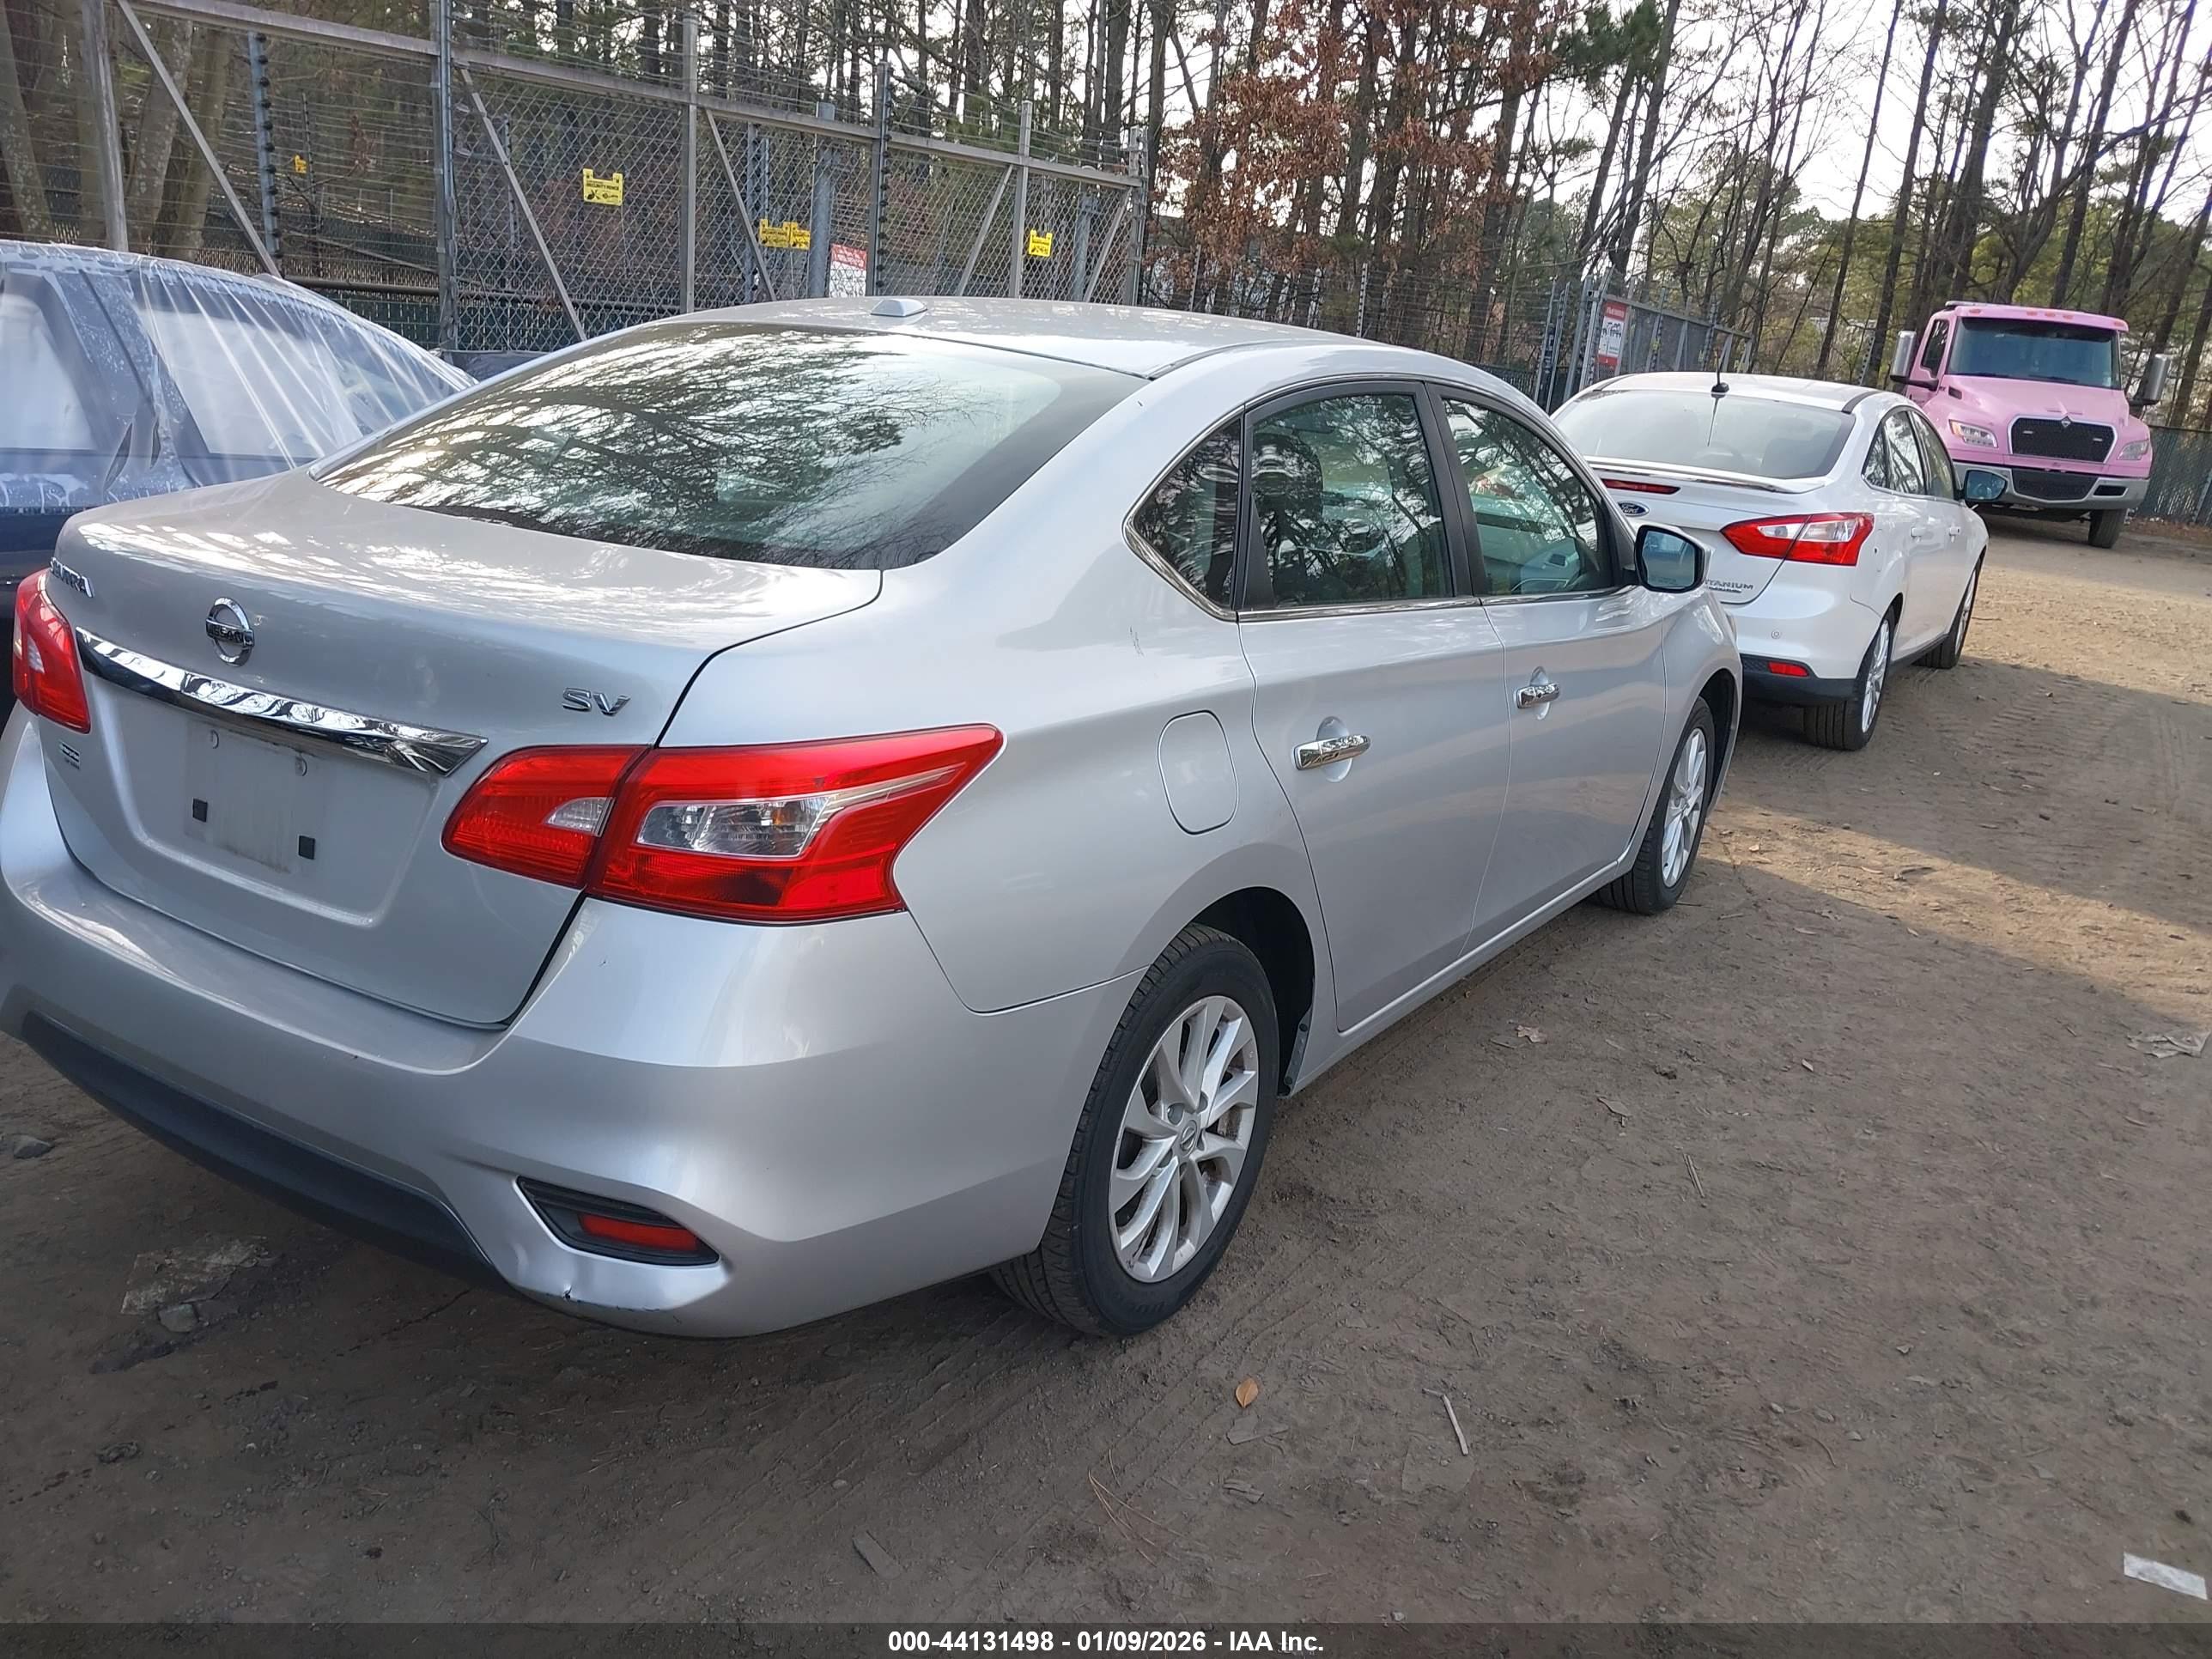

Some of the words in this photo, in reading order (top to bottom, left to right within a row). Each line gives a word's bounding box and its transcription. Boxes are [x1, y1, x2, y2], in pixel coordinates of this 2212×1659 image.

[1705, 579, 1753, 590] ITANIUM
[207, 623, 246, 645] NISSAN
[562, 687, 631, 717] SV
